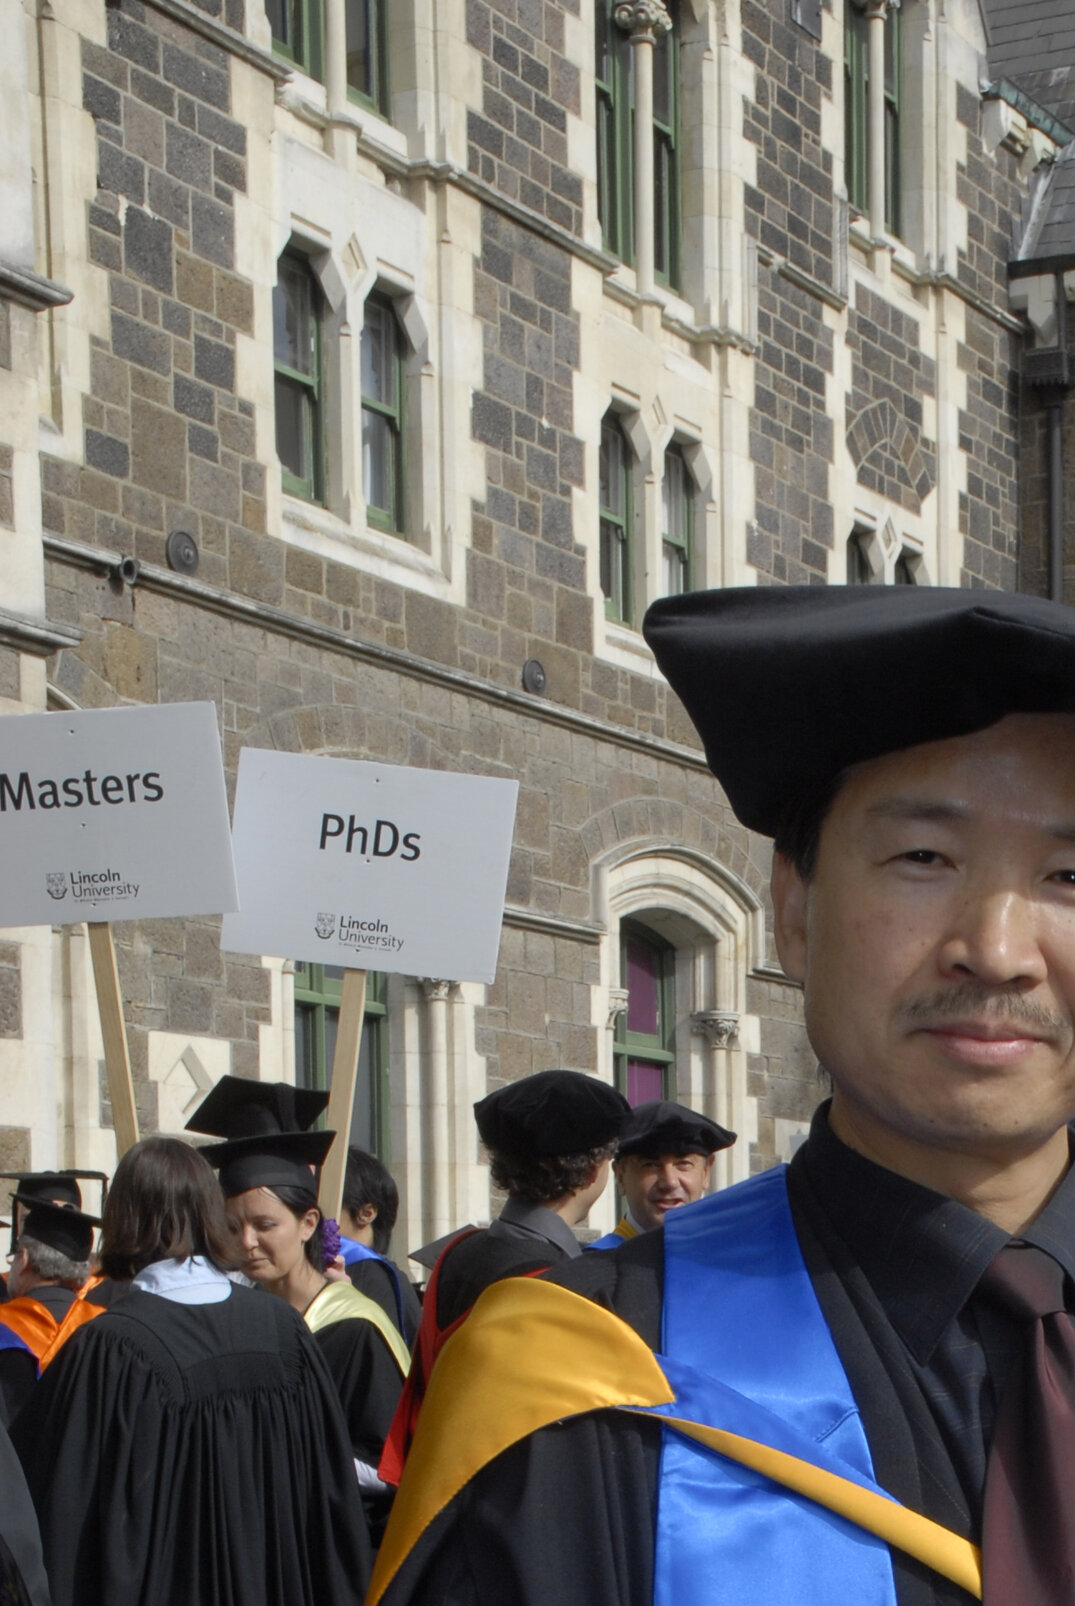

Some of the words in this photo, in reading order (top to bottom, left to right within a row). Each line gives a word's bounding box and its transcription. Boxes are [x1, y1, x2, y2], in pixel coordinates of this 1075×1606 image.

[0, 769, 164, 812] Masters
[319, 813, 421, 862] PhDs
[70, 868, 121, 885] Lincoln
[72, 882, 140, 899] University
[339, 915, 389, 934] Lincoln
[338, 928, 405, 952] University
